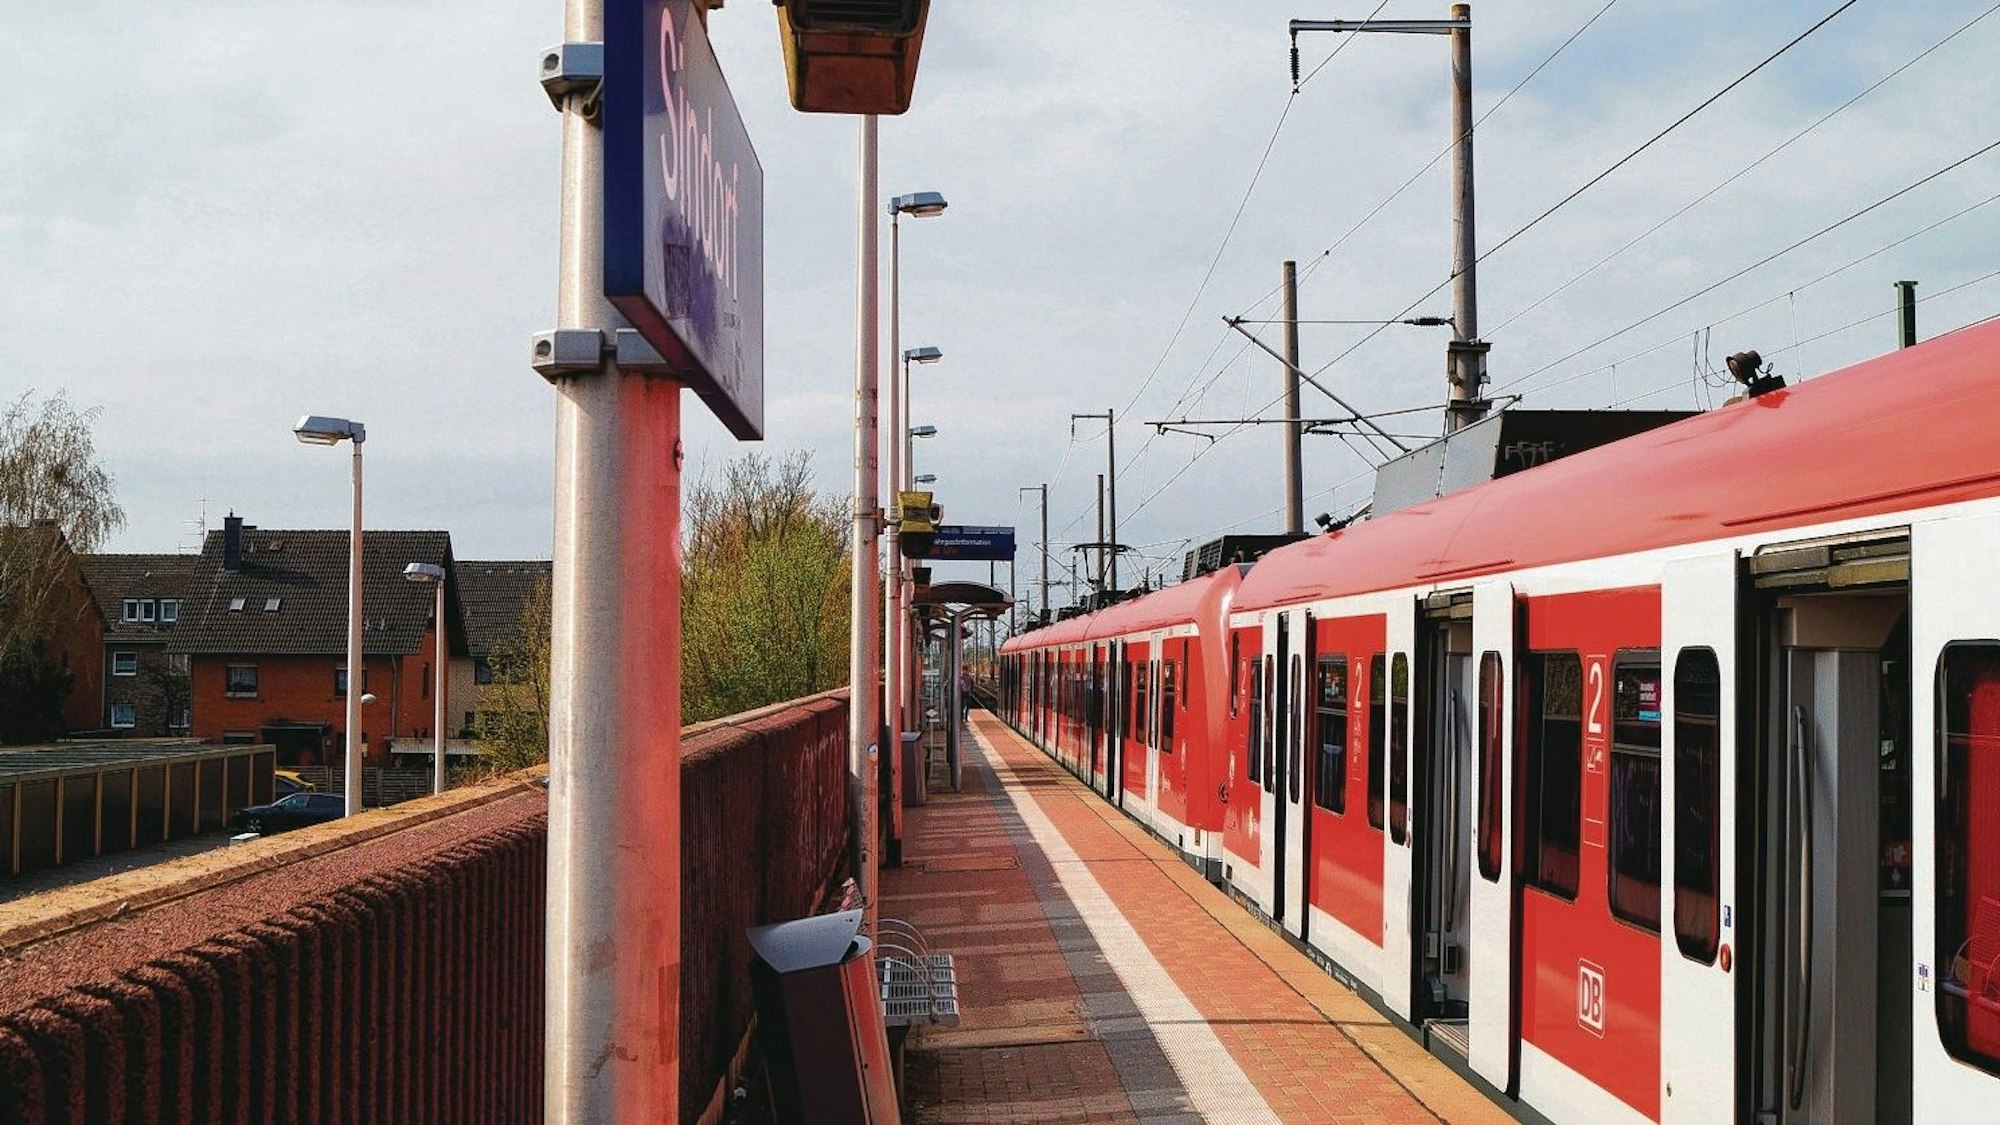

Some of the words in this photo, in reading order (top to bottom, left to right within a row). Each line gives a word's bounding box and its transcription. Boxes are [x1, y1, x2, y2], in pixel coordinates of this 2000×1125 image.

[660, 7, 738, 303] Sindorf
[1354, 661, 1363, 709] 2
[1588, 661, 1603, 734] 2
[1580, 970, 1603, 1025] DB
